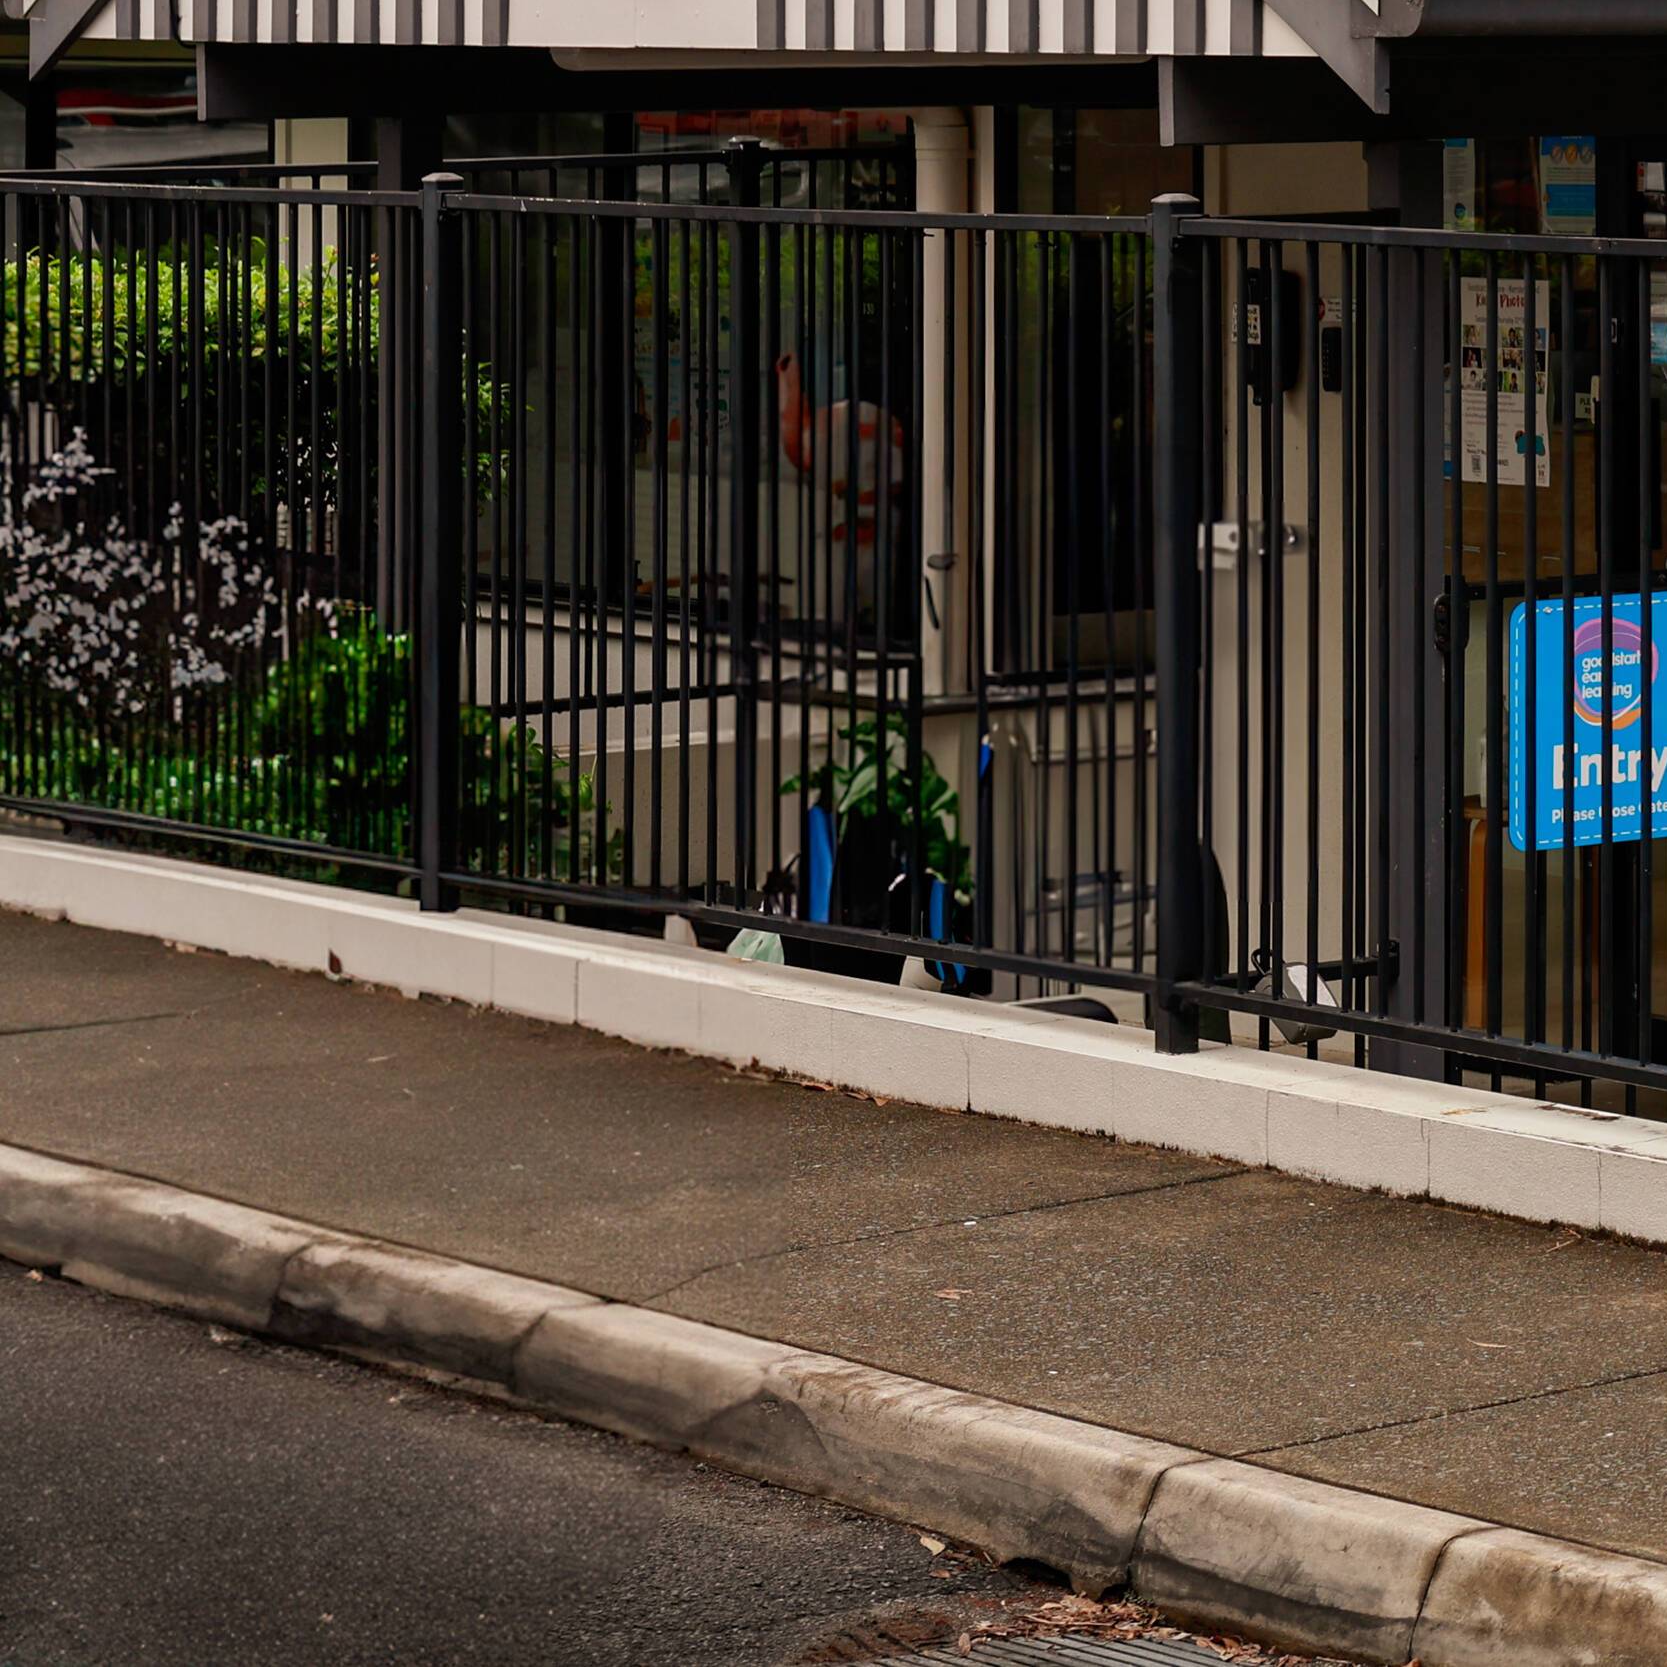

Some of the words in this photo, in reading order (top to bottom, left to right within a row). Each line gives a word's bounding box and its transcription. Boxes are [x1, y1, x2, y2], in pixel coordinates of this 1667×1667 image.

[1581, 650, 1641, 672] goostart
[1581, 681, 1633, 699] leaing
[1551, 808, 1596, 824] Plase
[1599, 804, 1636, 818] ose
